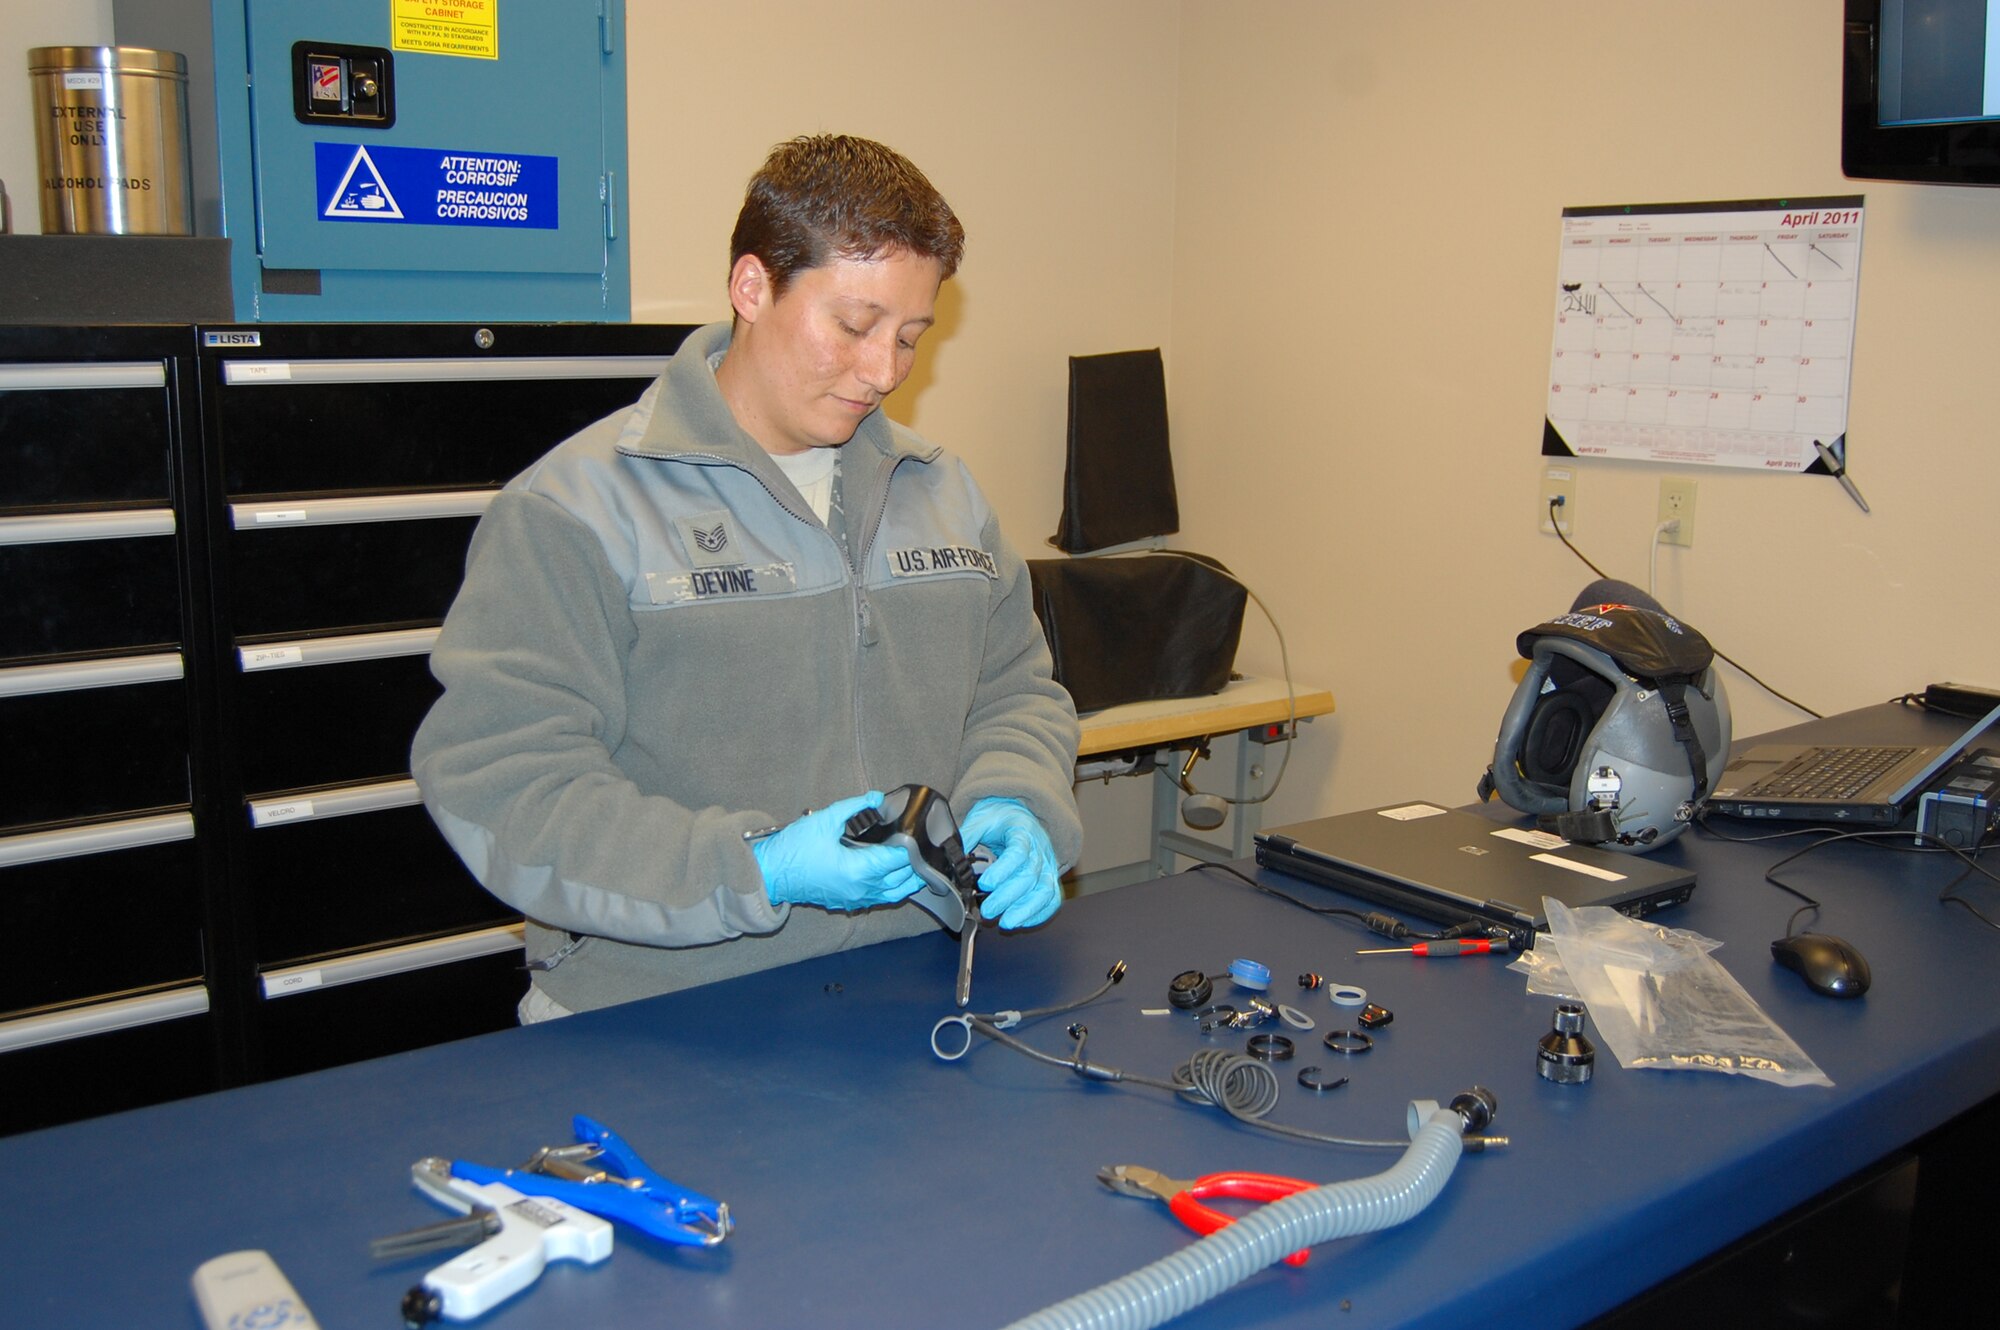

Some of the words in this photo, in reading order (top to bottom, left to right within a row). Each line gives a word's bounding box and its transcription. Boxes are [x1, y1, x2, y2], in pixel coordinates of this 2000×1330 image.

[425, 8, 464, 19] CABINET
[400, 21, 443, 31] CONSTRUCTED
[451, 26, 489, 35] ACCORDANCE
[451, 33, 484, 41] STANDARDS
[442, 42, 489, 52] REQUIREMENTS
[73, 120, 104, 133] USE
[440, 156, 522, 174] ATTENTION:
[45, 177, 104, 190] ALCOHOL
[112, 178, 152, 191] ADS
[446, 170, 518, 187] CORROSIF
[437, 189, 528, 207] PRECAUCION
[437, 204, 528, 221] CORROSIVOS
[1781, 211, 1820, 229] April
[1822, 211, 1860, 226] 2011
[1684, 235, 1718, 243] WEDNESDAY
[1818, 232, 1849, 240] SATURDAY
[220, 334, 255, 344] LISTA
[1712, 355, 1722, 363] 21
[1755, 356, 1766, 364] 22
[1578, 446, 1592, 455] April
[1593, 447, 1607, 455] 2011
[1765, 459, 1783, 468] April
[1784, 460, 1801, 468] 2011
[896, 550, 929, 573] U.S.
[931, 547, 959, 569] AIR
[957, 546, 996, 574] FORCE
[691, 569, 758, 596] DEVINE
[267, 807, 296, 817] VELCRO
[283, 976, 303, 986] CORD
